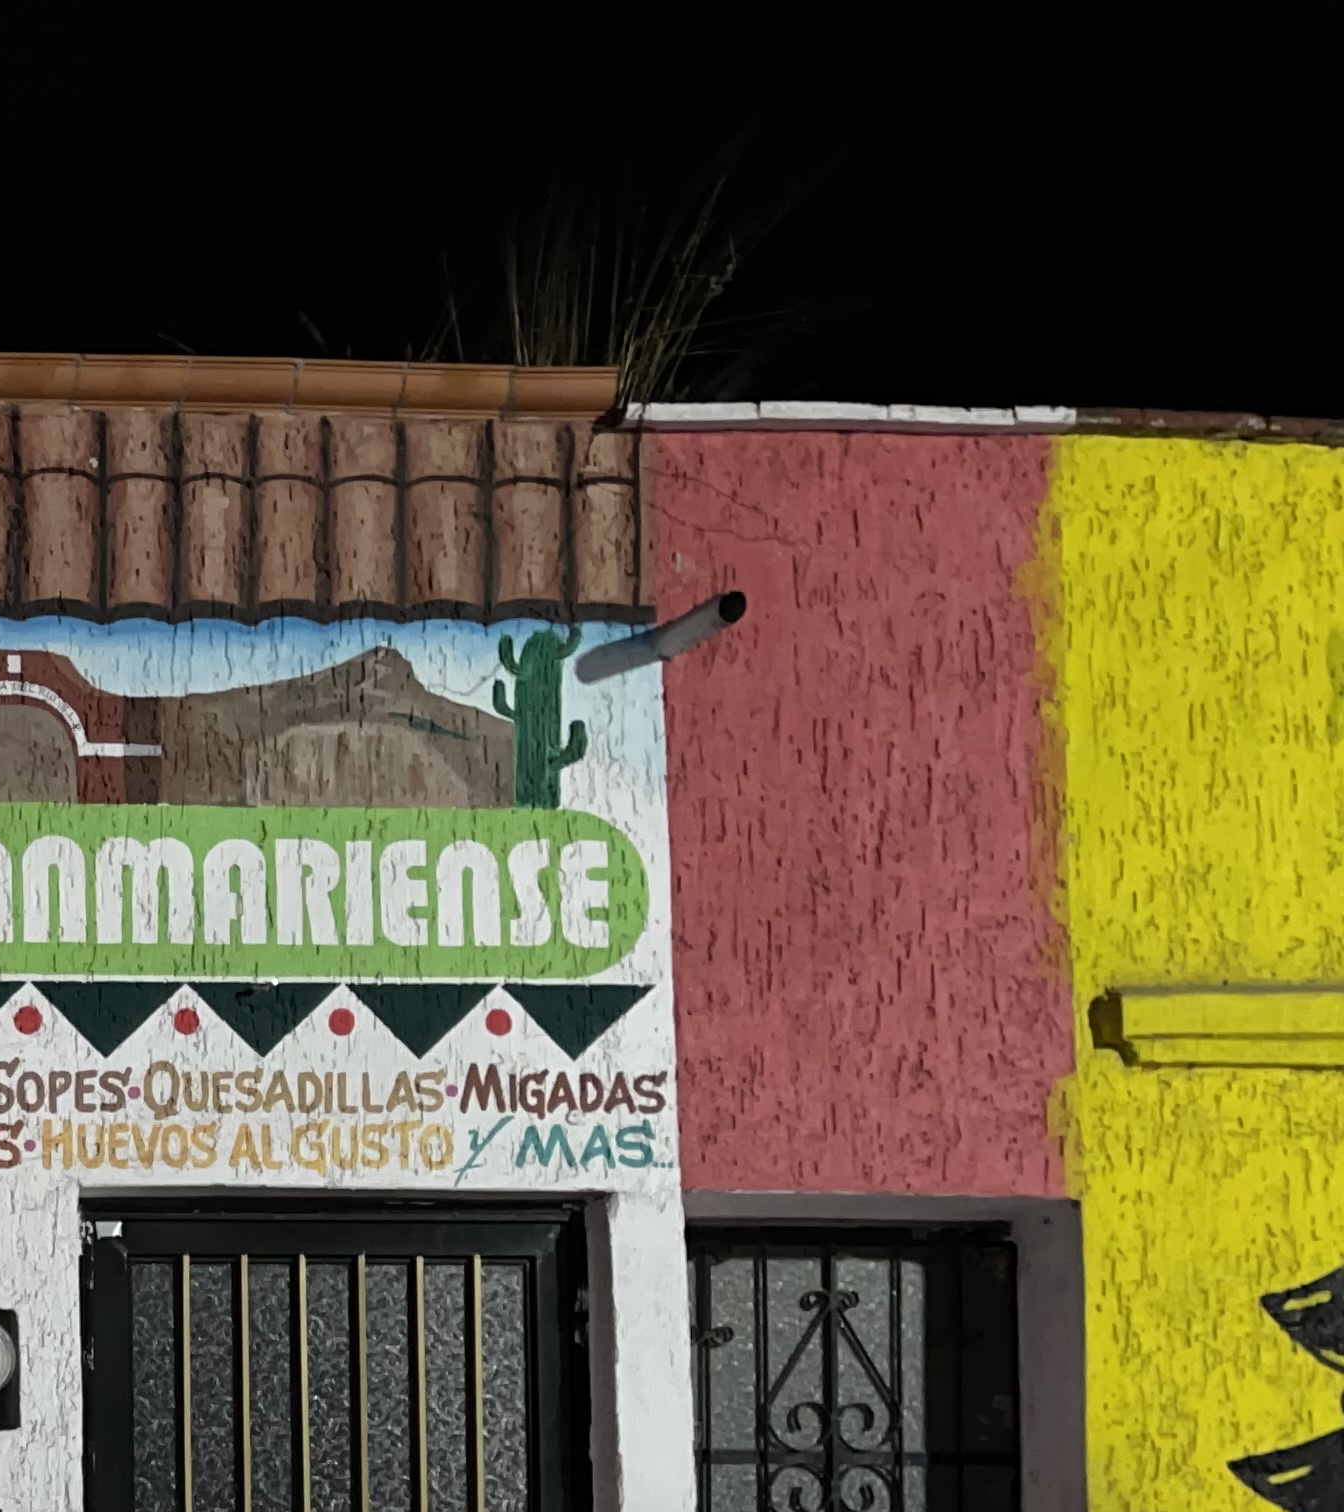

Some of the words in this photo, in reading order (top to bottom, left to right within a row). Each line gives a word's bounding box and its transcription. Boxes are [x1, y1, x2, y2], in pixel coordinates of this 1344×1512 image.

[143, 1060, 448, 1120] QUESADILLAS
[459, 1063, 668, 1120] MIGADAS
[41, 1120, 218, 1169] HUEVOS
[229, 1123, 284, 1169] AL
[290, 1119, 454, 1176] GUSTO
